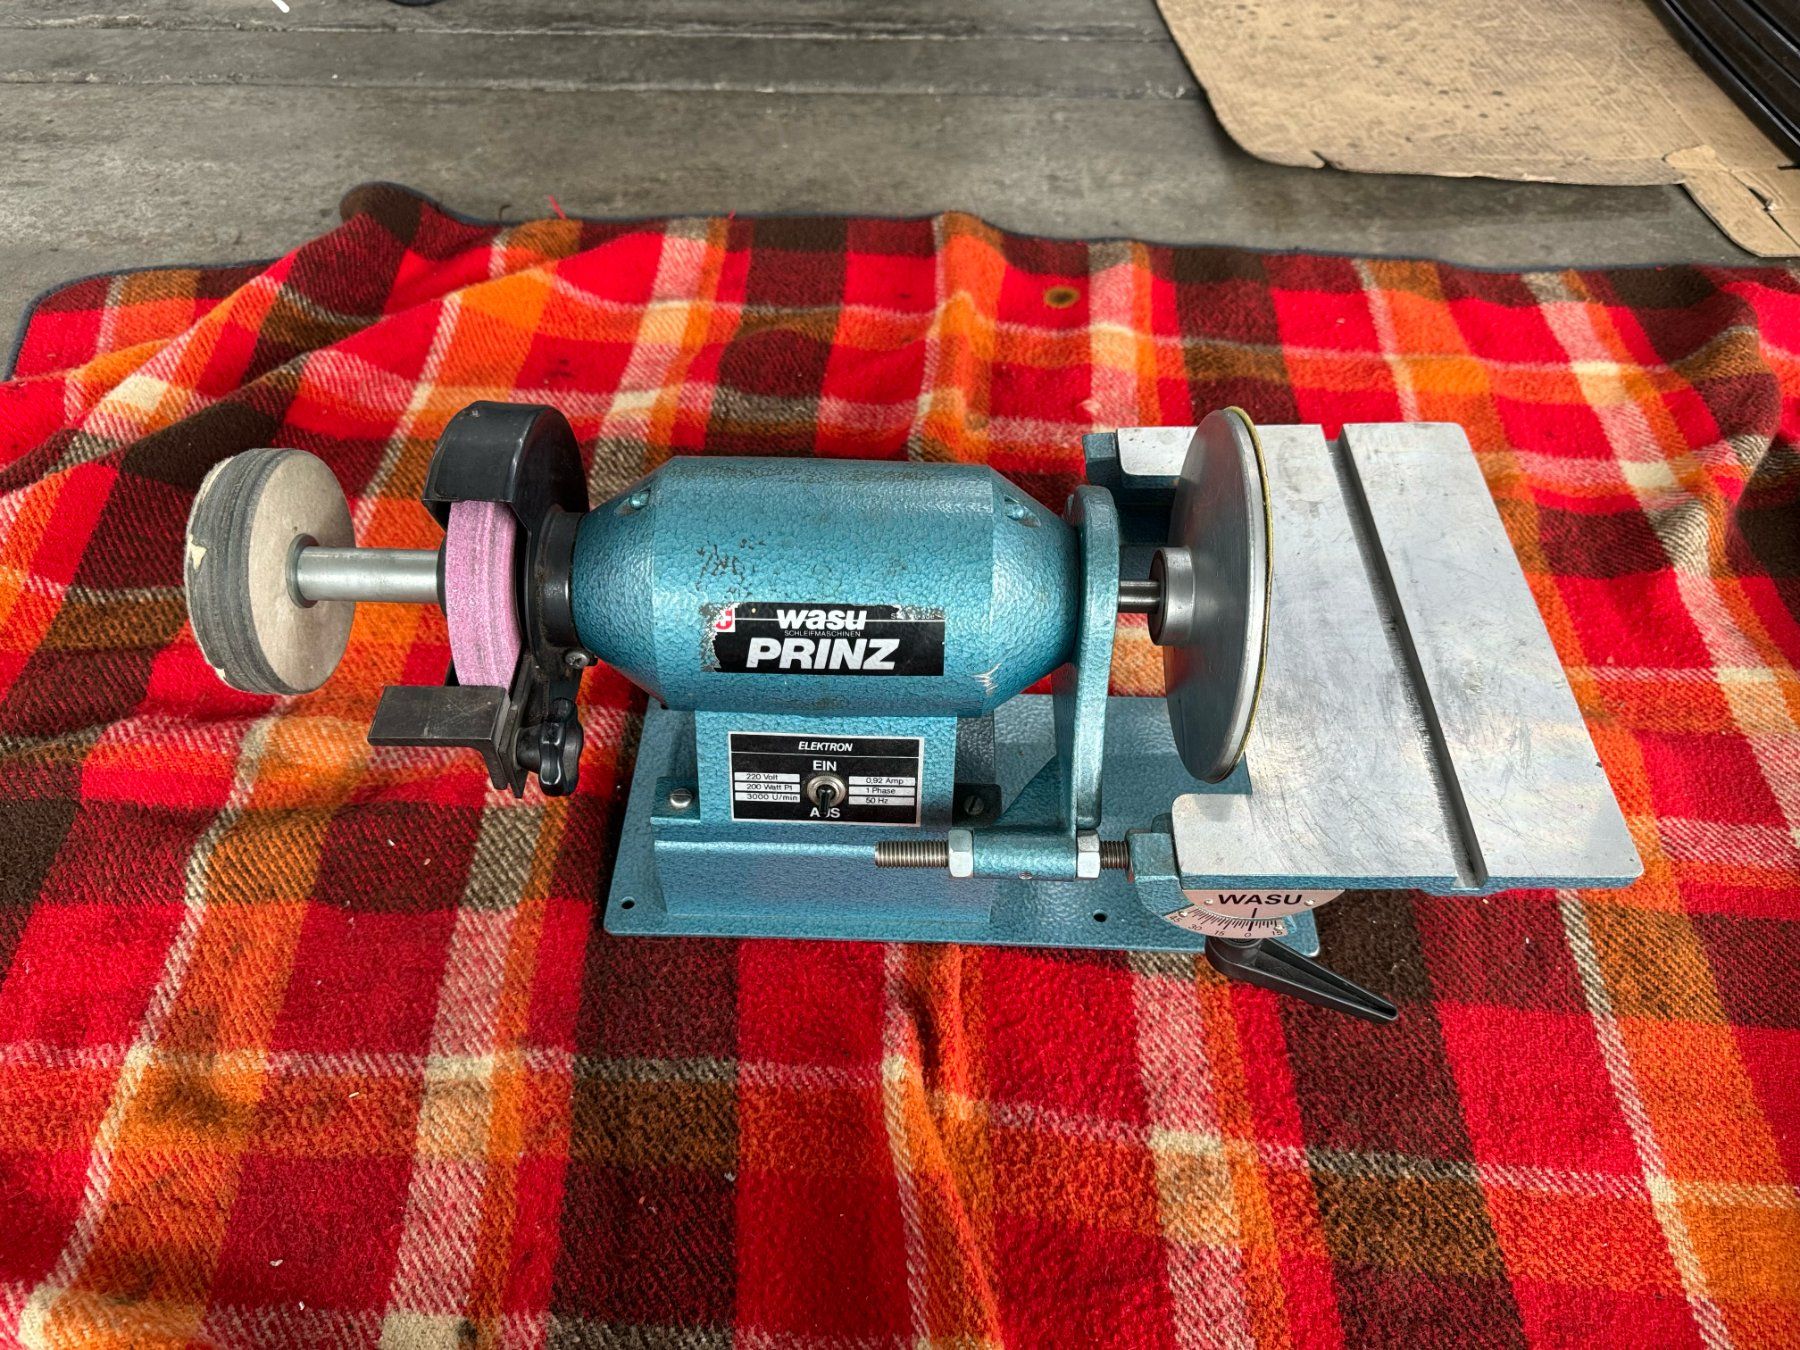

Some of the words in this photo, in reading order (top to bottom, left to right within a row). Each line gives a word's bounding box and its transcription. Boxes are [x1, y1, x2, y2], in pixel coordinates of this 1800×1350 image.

[777, 609, 867, 630] wasu
[745, 637, 900, 670] PRINZ
[798, 741, 853, 752] ELEKTRON
[813, 760, 837, 771] EIN
[885, 778, 904, 786] Amp
[1218, 894, 1303, 905] WASU
[1169, 914, 1183, 923] 45
[1188, 923, 1202, 931] 30
